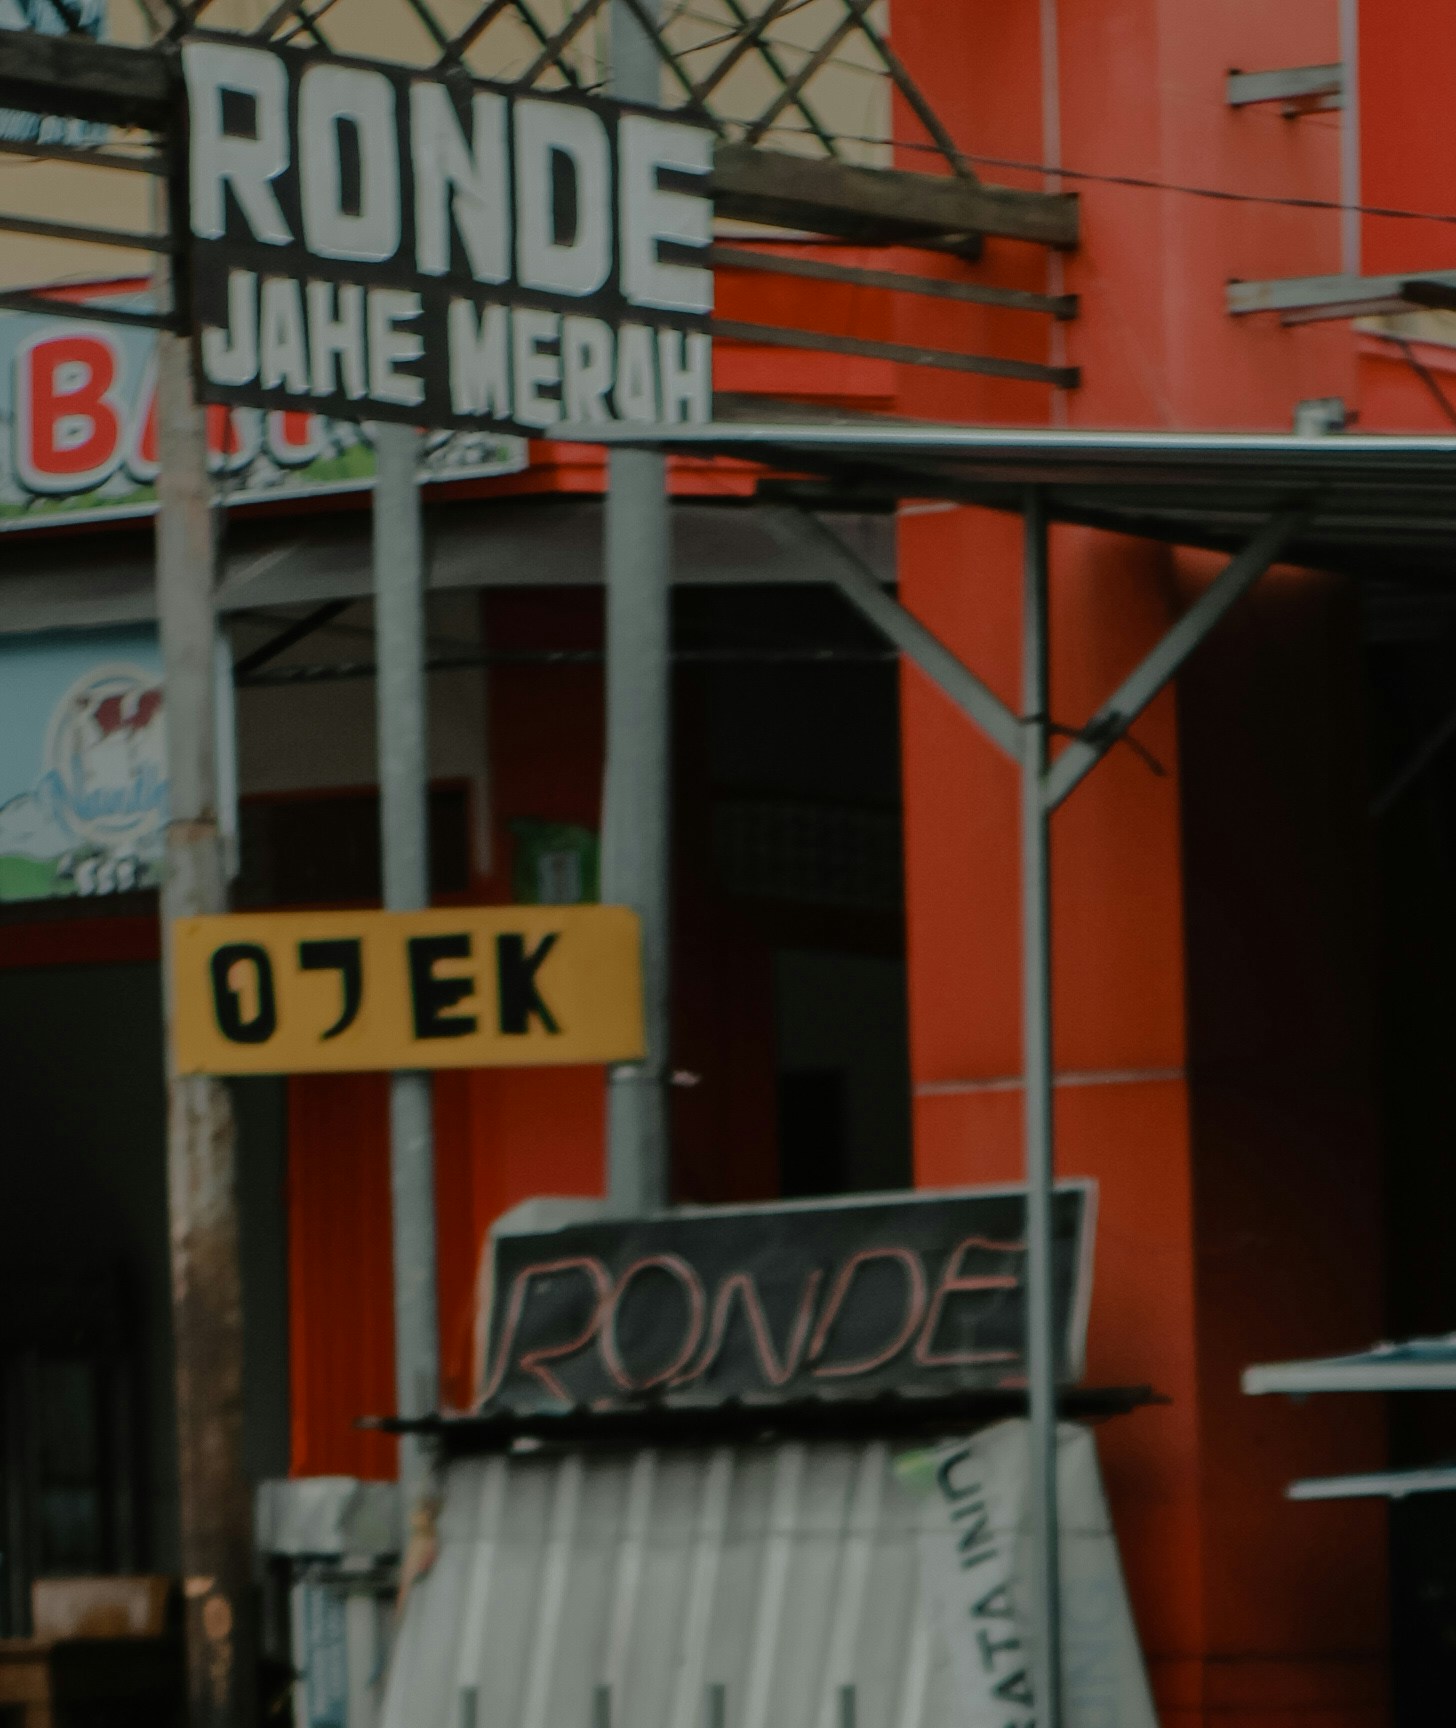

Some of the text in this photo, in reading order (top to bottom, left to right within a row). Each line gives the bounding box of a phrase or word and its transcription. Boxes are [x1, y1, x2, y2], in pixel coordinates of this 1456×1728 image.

[181, 42, 715, 316] RONDE
[202, 267, 427, 408] JAHE
[448, 296, 712, 428] MERAH
[209, 930, 563, 1046] OJEK
[480, 1235, 1028, 1402] RONDE
